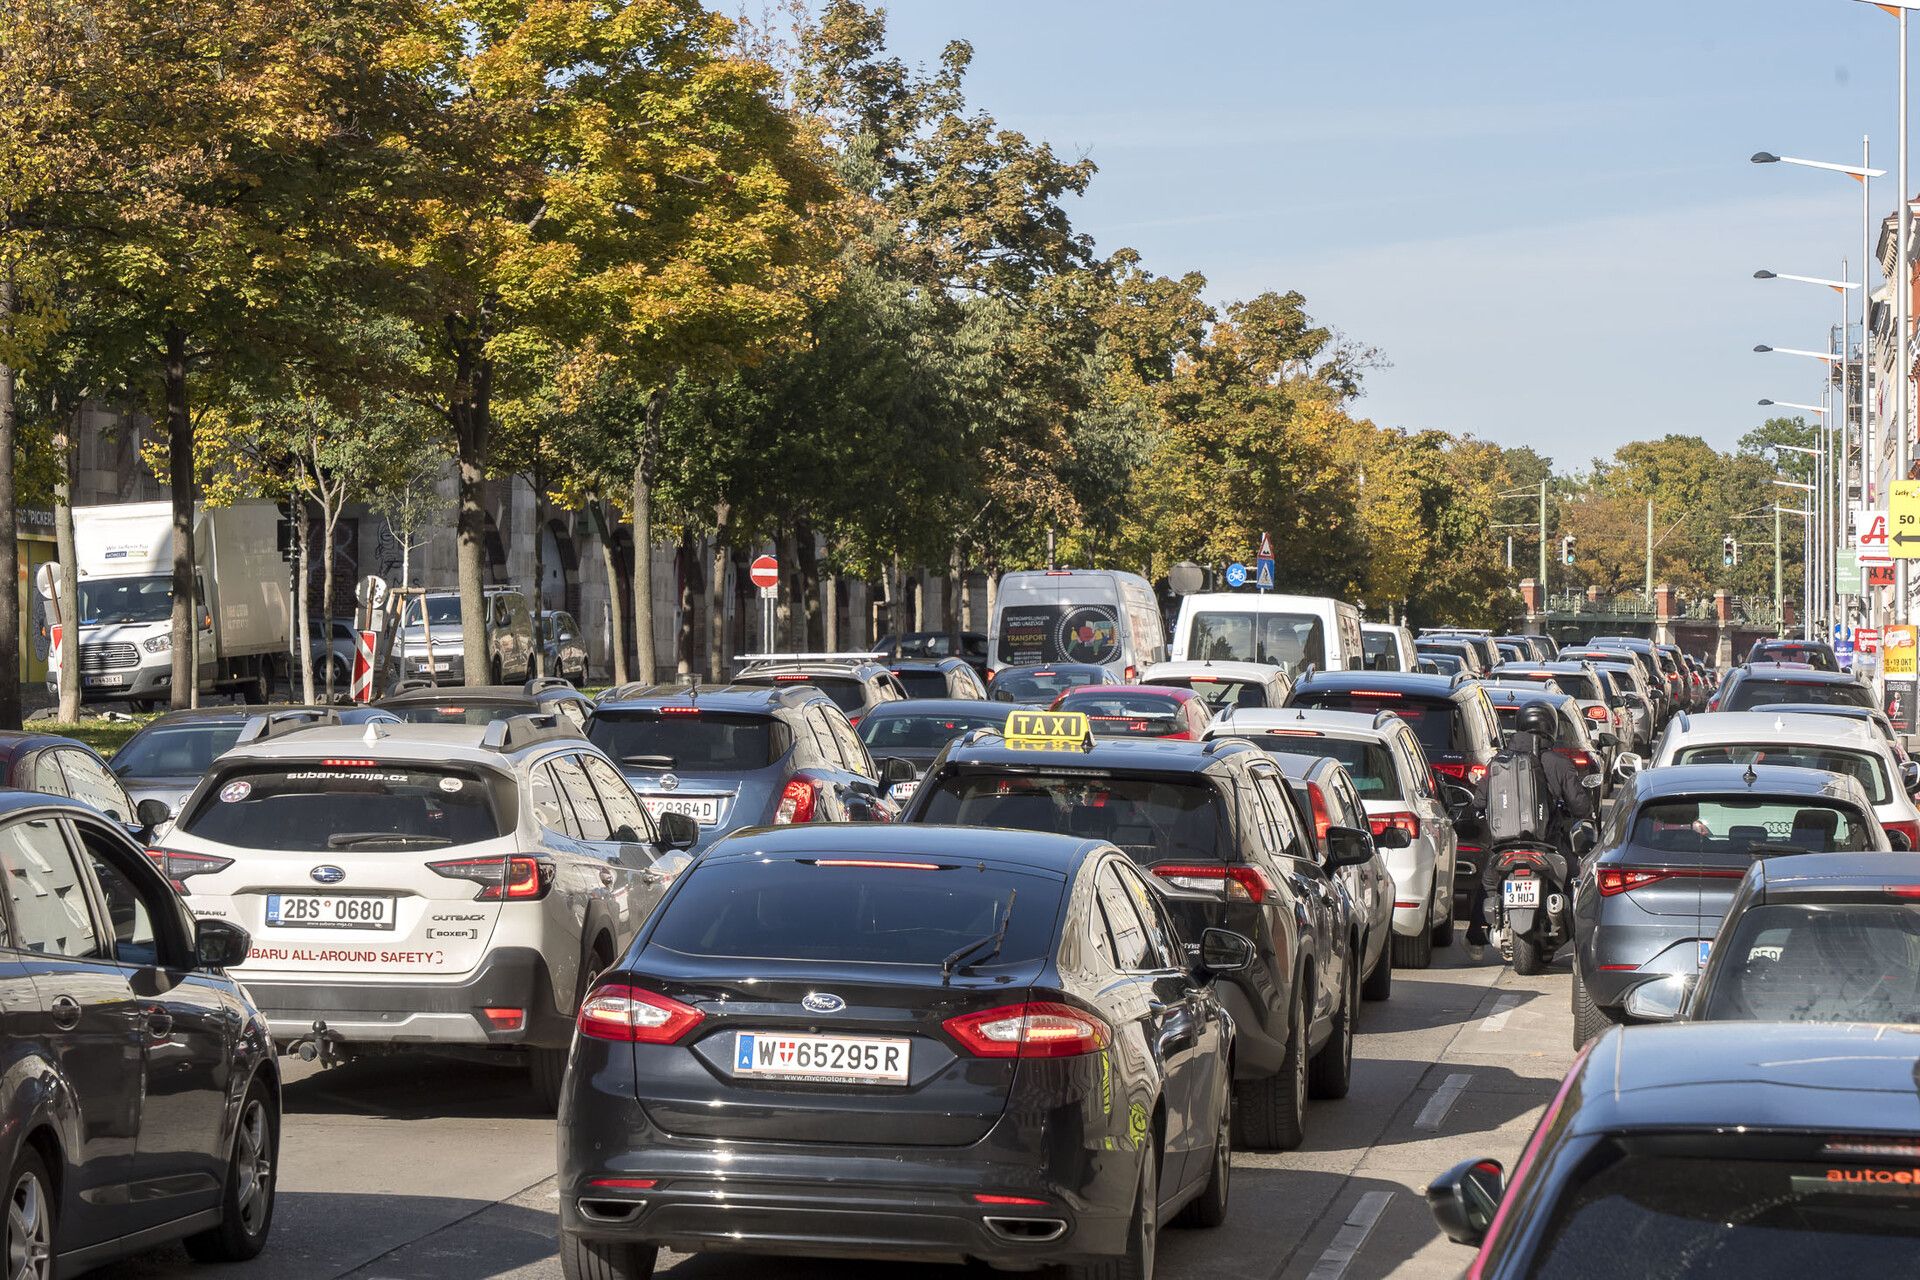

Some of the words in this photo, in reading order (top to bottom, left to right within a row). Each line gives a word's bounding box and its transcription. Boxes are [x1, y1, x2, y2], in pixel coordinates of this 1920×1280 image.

[1899, 515, 1915, 524] 50
[1018, 716, 1077, 736] TAXI
[286, 771, 409, 783] subaru-mija.cz
[1515, 882, 1523, 892] W
[1509, 893, 1515, 903] 3
[284, 898, 320, 919] 2BS
[335, 899, 384, 921] 0680
[292, 950, 377, 963] ALL-AROUND
[381, 951, 434, 964] SAFETY
